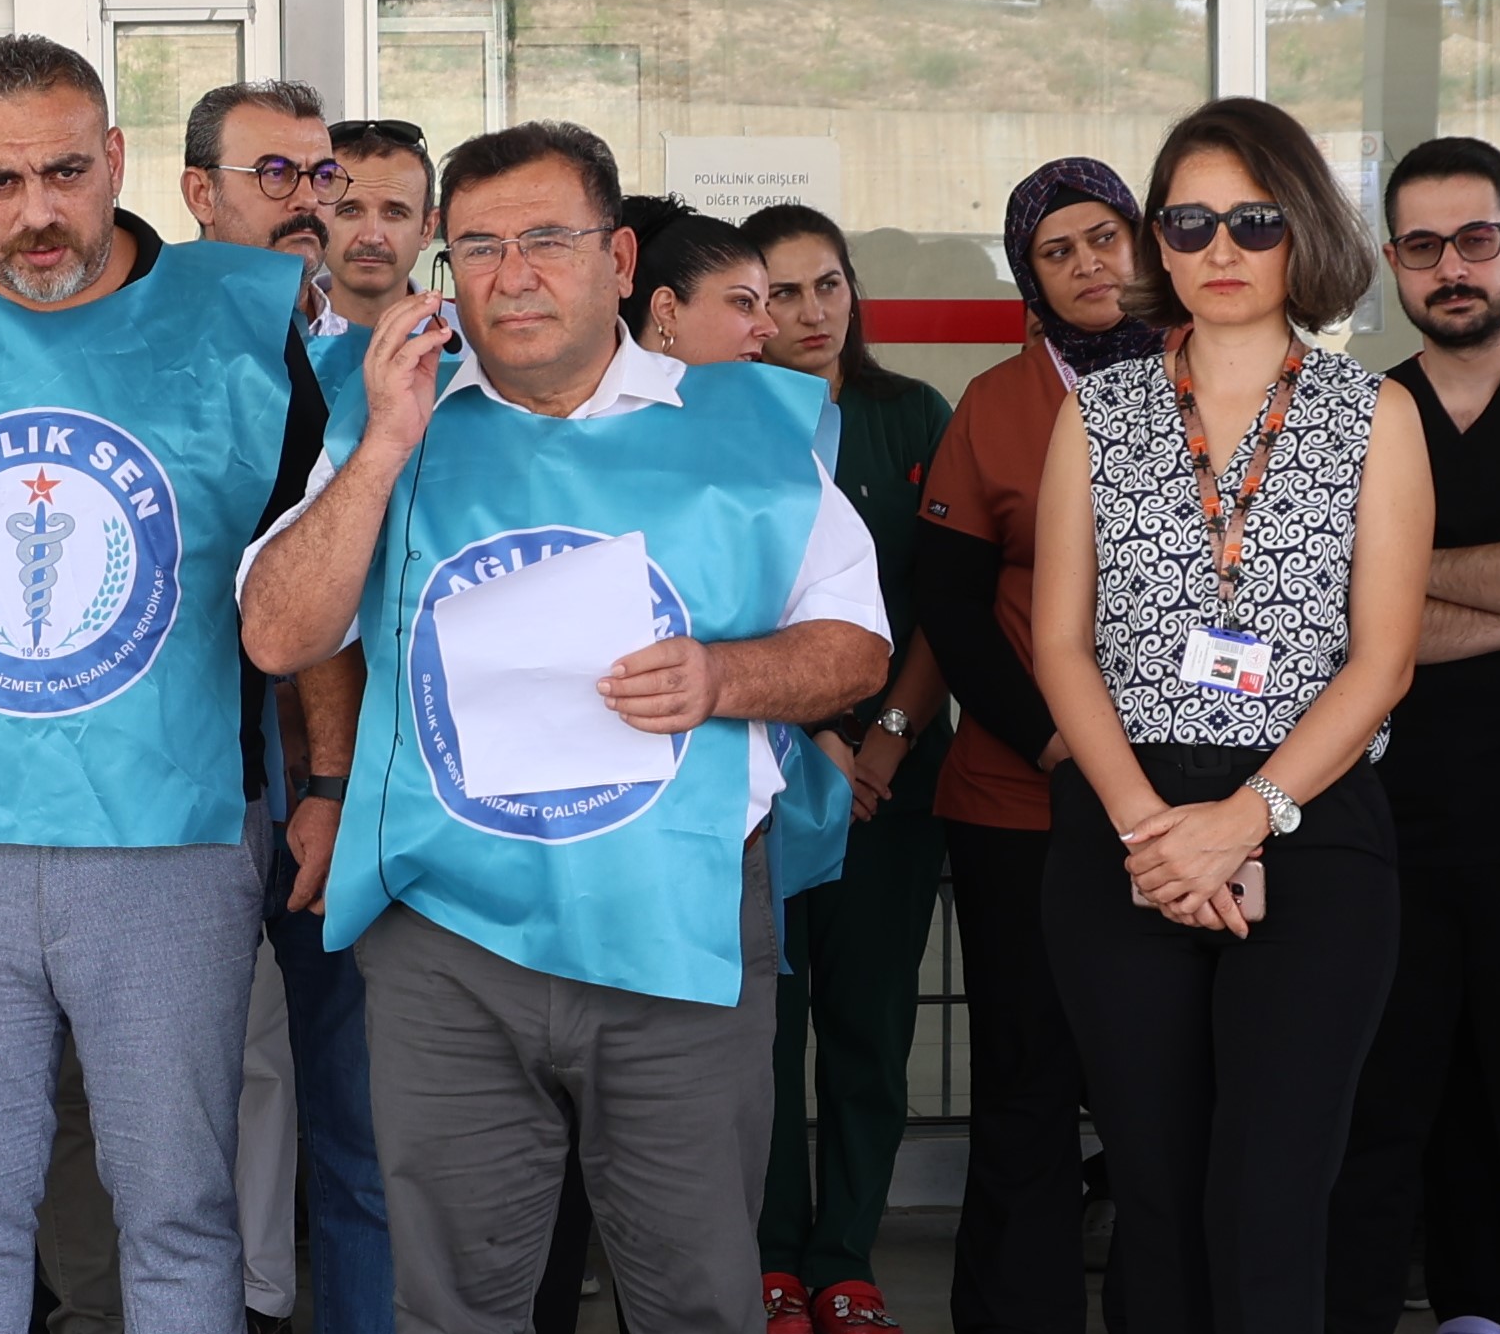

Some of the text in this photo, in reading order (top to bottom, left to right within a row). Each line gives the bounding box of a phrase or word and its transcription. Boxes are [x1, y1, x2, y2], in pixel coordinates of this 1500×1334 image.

[694, 172, 809, 186] POLİKLİNİK GİRİŞLERİ
[706, 193, 801, 206] DİĞER TARAFTAN
[88, 441, 161, 521] SEN
[47, 640, 136, 694] ÇALIŞANLARI
[421, 673, 439, 731] SAĞLIK
[432, 731, 446, 753] VE
